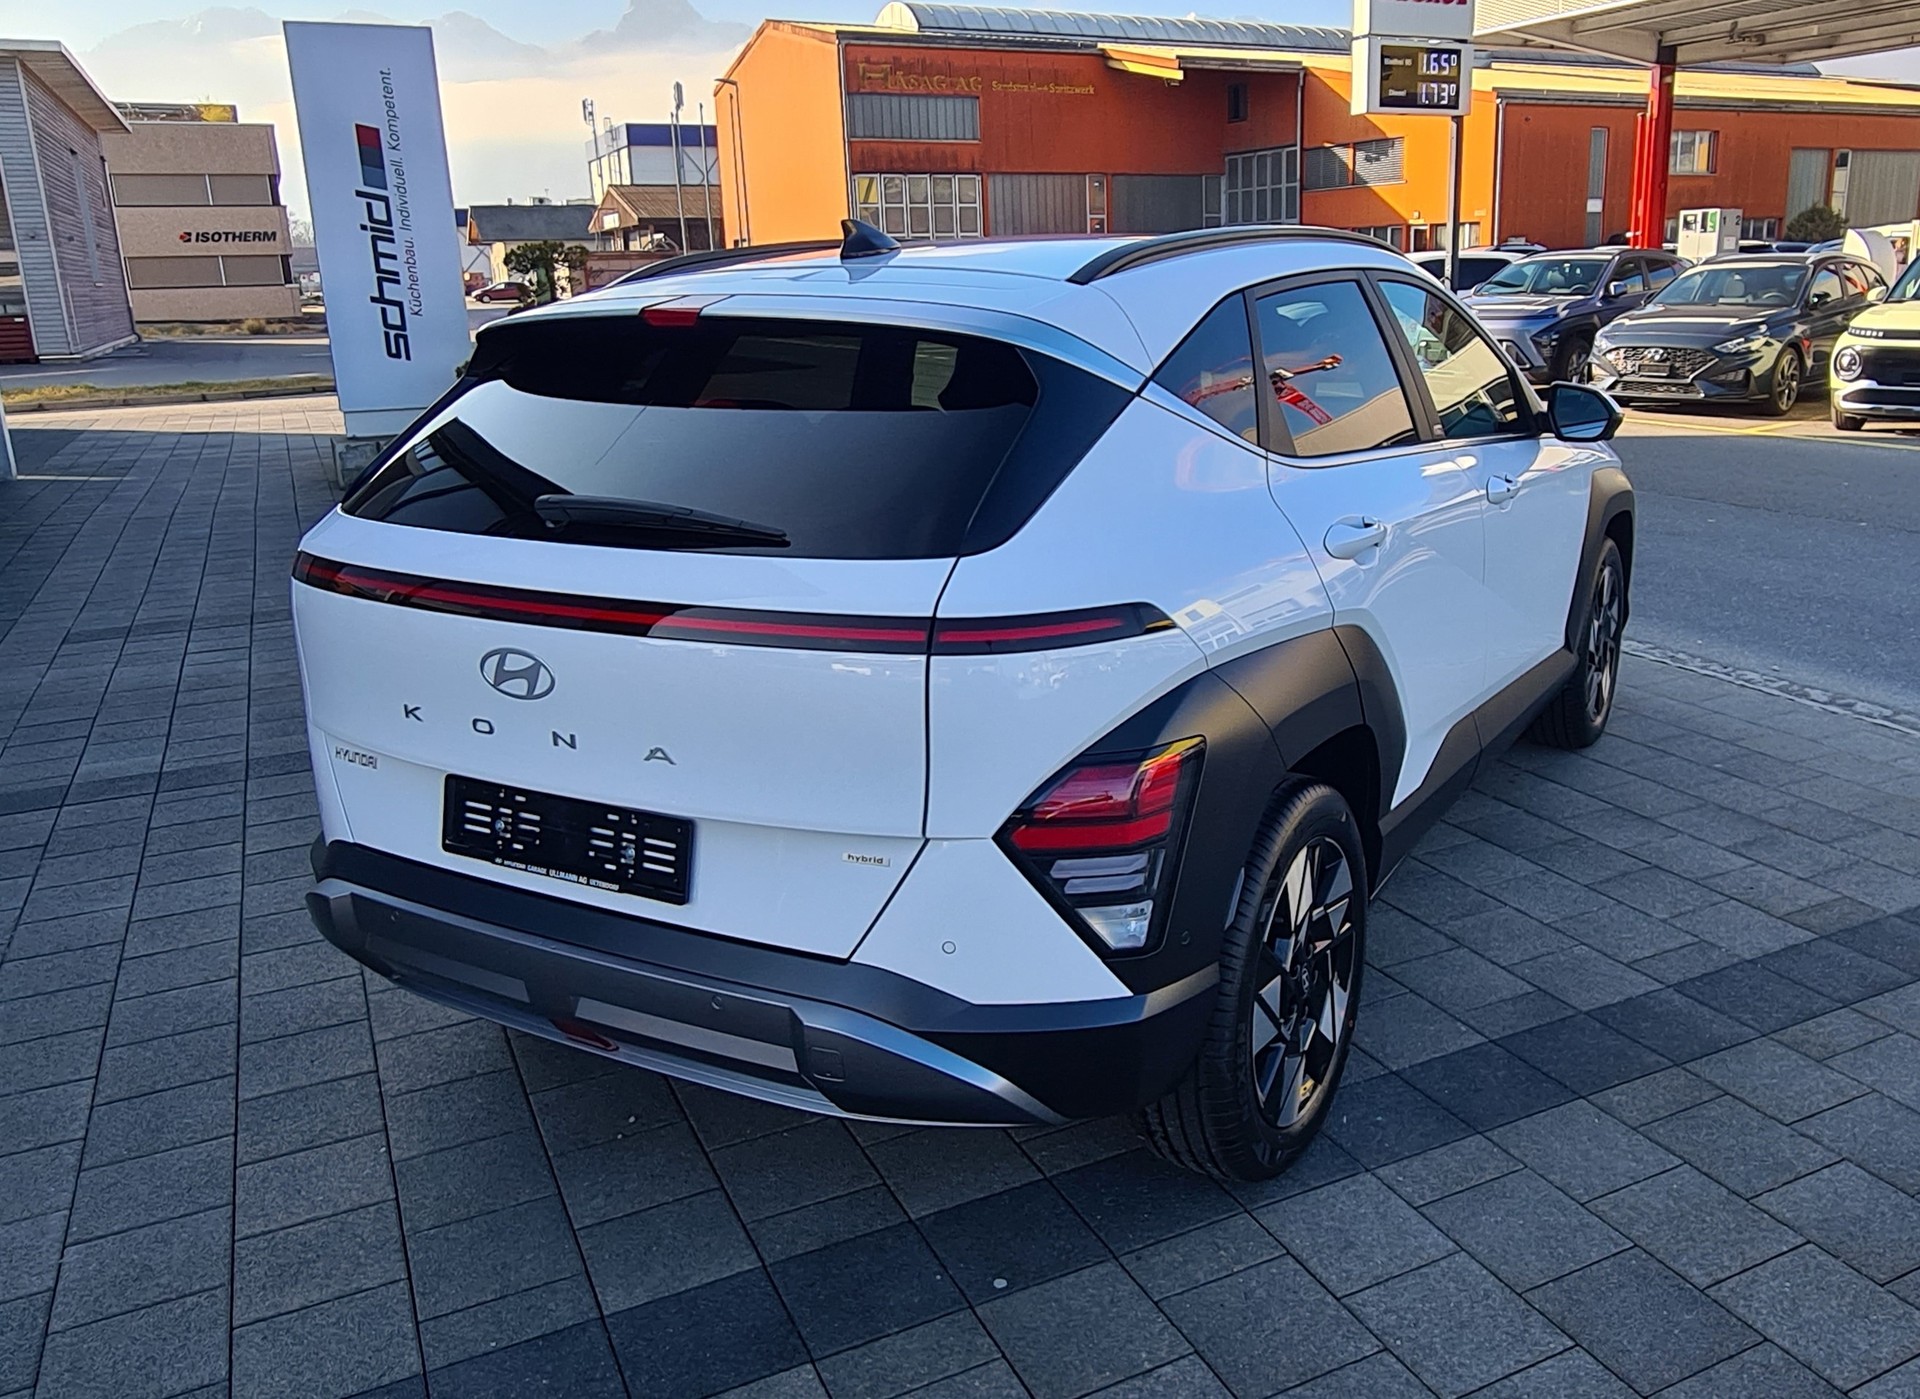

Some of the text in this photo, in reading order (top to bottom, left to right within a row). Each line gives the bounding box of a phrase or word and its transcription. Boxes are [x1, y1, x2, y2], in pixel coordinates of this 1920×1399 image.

[956, 75, 983, 92] AG
[380, 67, 423, 317] Küchenbau. Individuell. Kompetent.
[195, 231, 277, 243] ISOTHERM
[355, 190, 411, 361] schmid
[403, 703, 677, 765] KONA
[335, 746, 378, 769] HYUNDAI
[847, 853, 884, 865] hybrid
